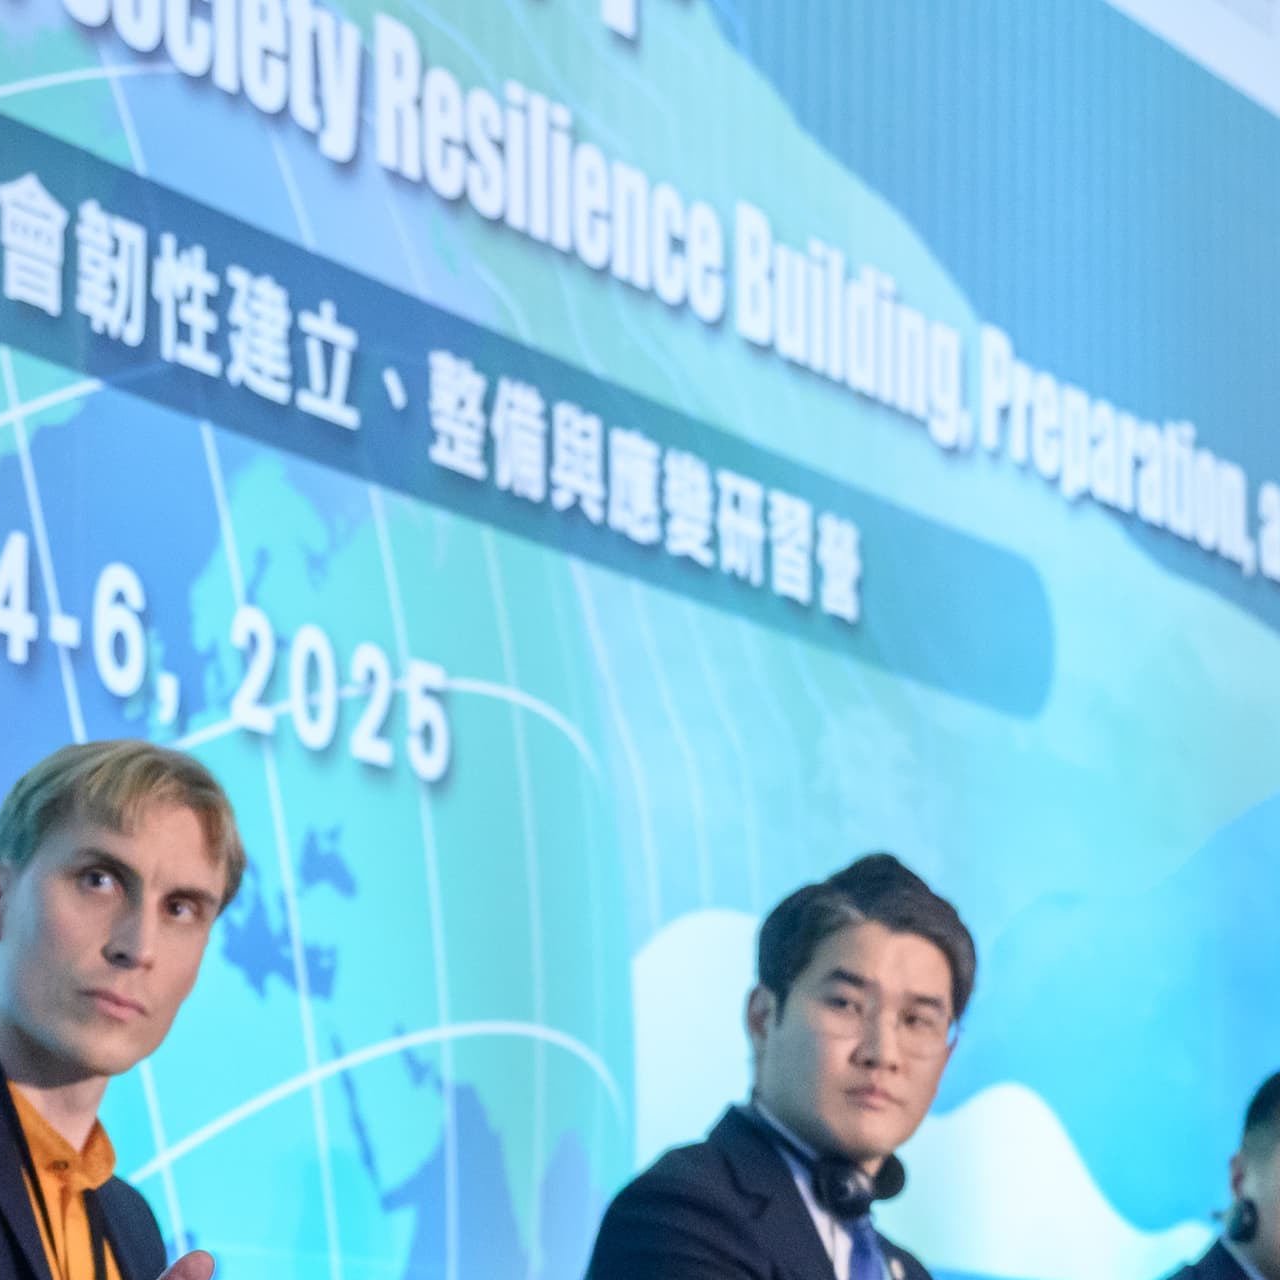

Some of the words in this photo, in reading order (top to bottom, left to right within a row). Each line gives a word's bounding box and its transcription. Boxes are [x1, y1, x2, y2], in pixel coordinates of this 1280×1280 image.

[64, 0, 360, 163] ciety
[374, 11, 723, 323] Resilience
[734, 201, 972, 449] Building,
[979, 322, 1255, 576] Preparation,
[229, 603, 451, 781] 2025
